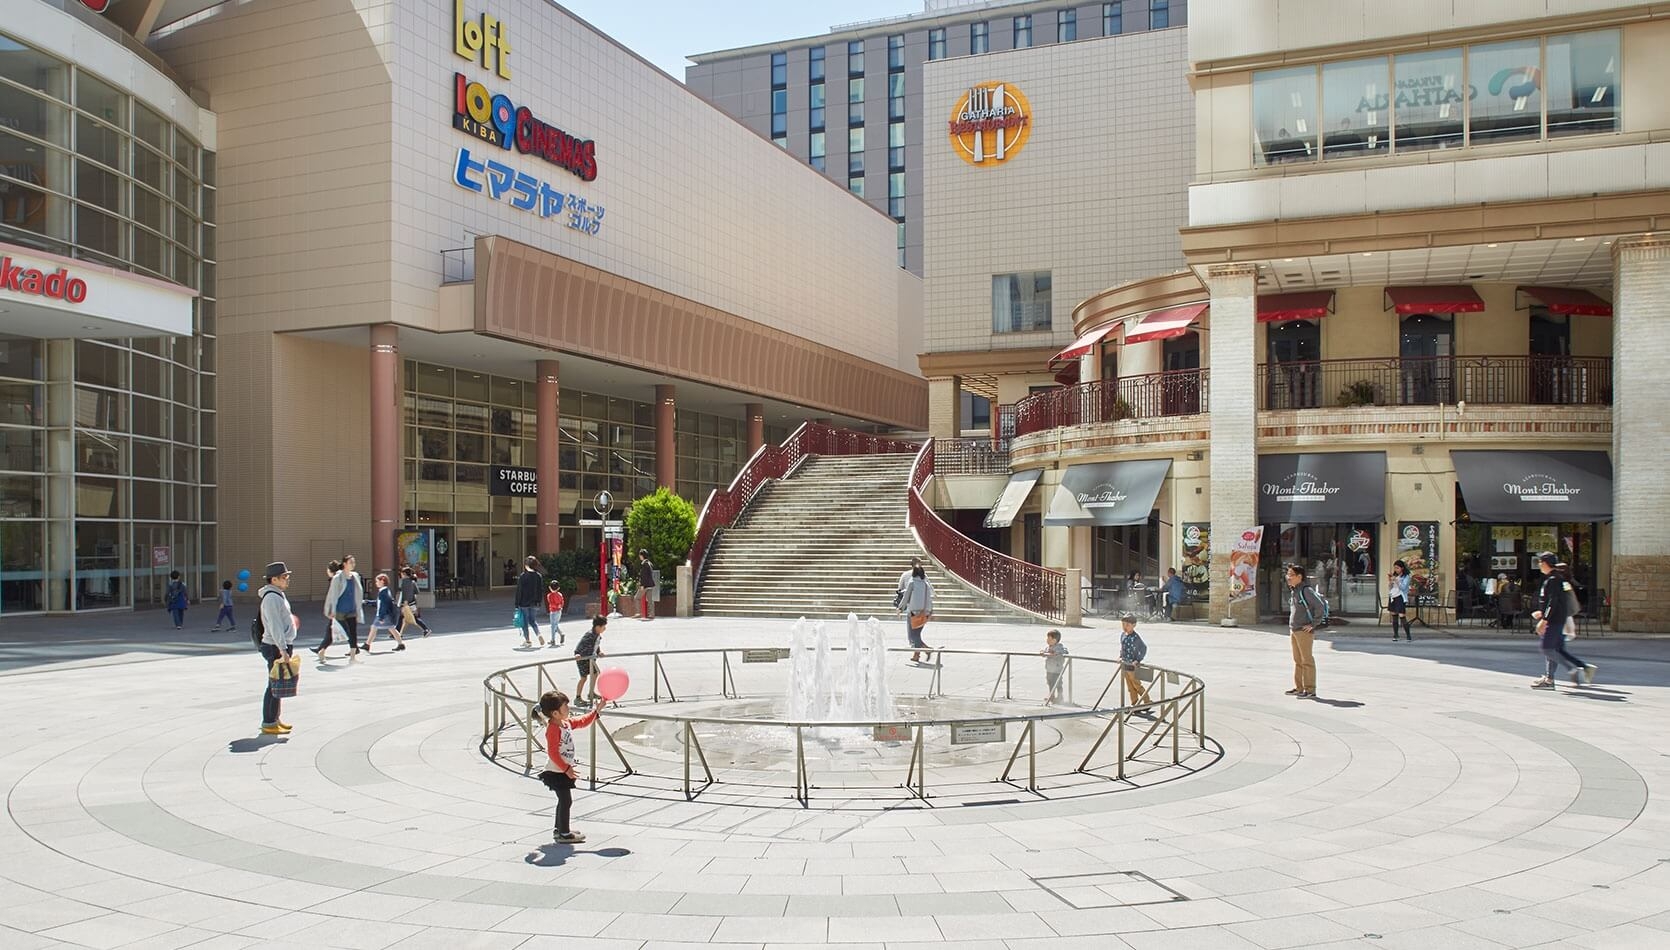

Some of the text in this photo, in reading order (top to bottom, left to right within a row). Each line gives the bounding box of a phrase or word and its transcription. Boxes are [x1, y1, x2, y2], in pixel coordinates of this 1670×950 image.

[455, 71, 597, 182] 109 CINEMAS
[462, 118, 497, 142] KIBA
[961, 106, 1015, 121] GATHARIA
[454, 147, 565, 218] ヒマラヤ
[0, 256, 88, 304] kado
[500, 469, 537, 481] STARBU
